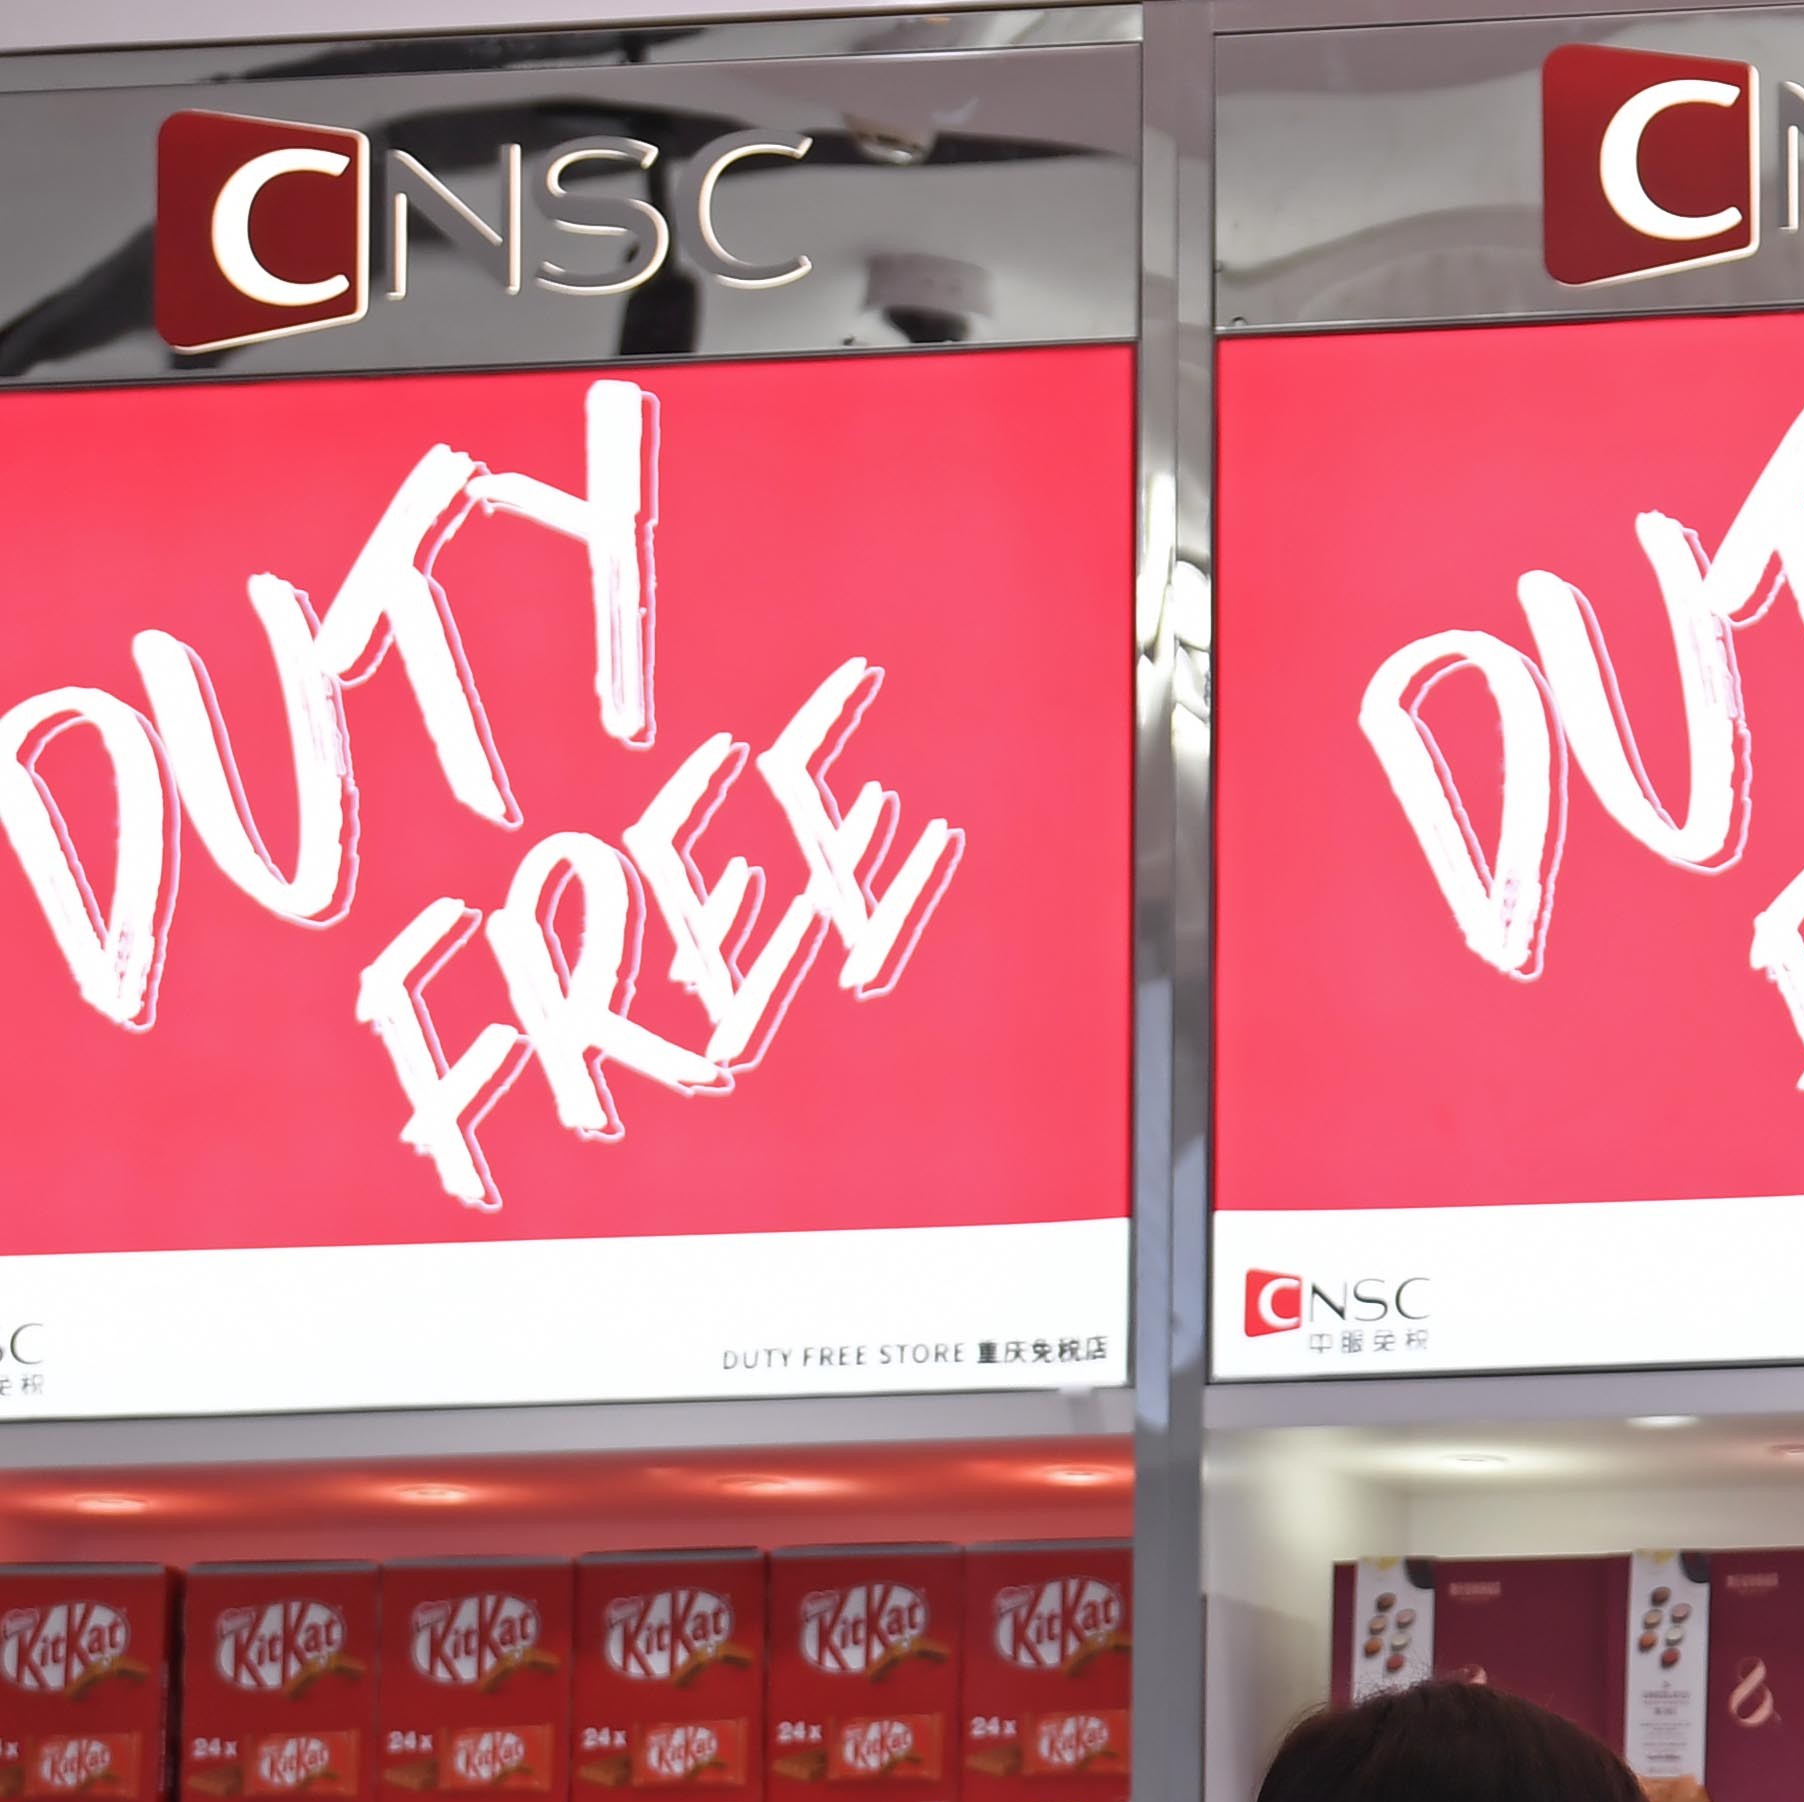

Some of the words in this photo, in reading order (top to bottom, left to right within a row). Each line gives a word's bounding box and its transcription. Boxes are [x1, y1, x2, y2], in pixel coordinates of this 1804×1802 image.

[210, 132, 813, 308] CNSC
[0, 379, 660, 1031] DUTY
[355, 655, 965, 1211] FREE
[1258, 1277, 1430, 1328] CNSC
[723, 1348, 792, 1370] DUTY
[802, 1345, 867, 1367] FREE
[880, 1341, 966, 1365] STORE
[977, 1335, 1108, 1363] 重庆免税店
[12, 1602, 124, 1690] KitKat
[232, 1601, 340, 1690] KitKat
[428, 1596, 534, 1684] KitKat
[620, 1589, 728, 1679] KitKat
[816, 1584, 923, 1672] KitKat
[1010, 1578, 1117, 1668] KitKat
